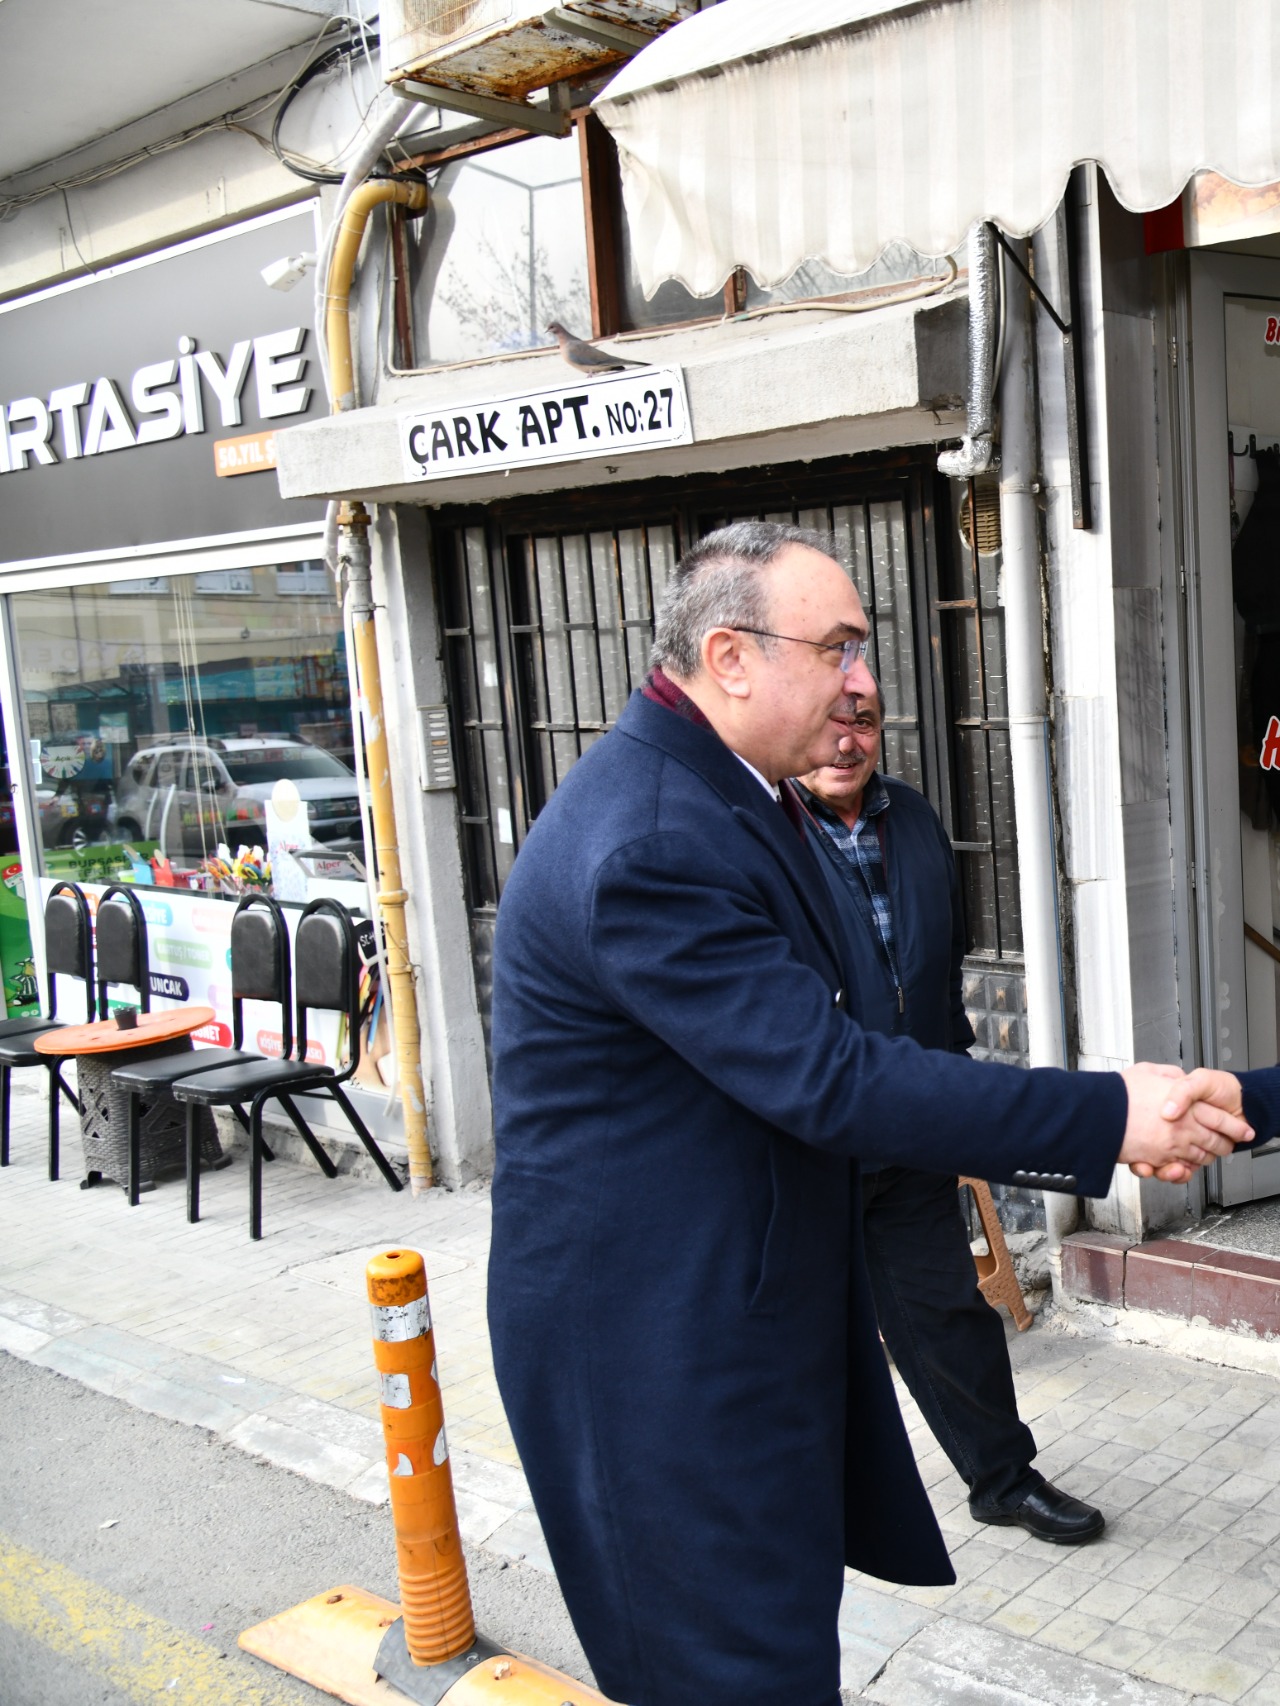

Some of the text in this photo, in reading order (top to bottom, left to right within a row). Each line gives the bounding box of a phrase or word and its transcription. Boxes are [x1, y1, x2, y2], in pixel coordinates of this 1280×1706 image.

[408, 410, 508, 476] ÇARK
[518, 394, 601, 448] APT.
[218, 441, 265, 469] 50.YIL
[316, 860, 342, 871] Alper
